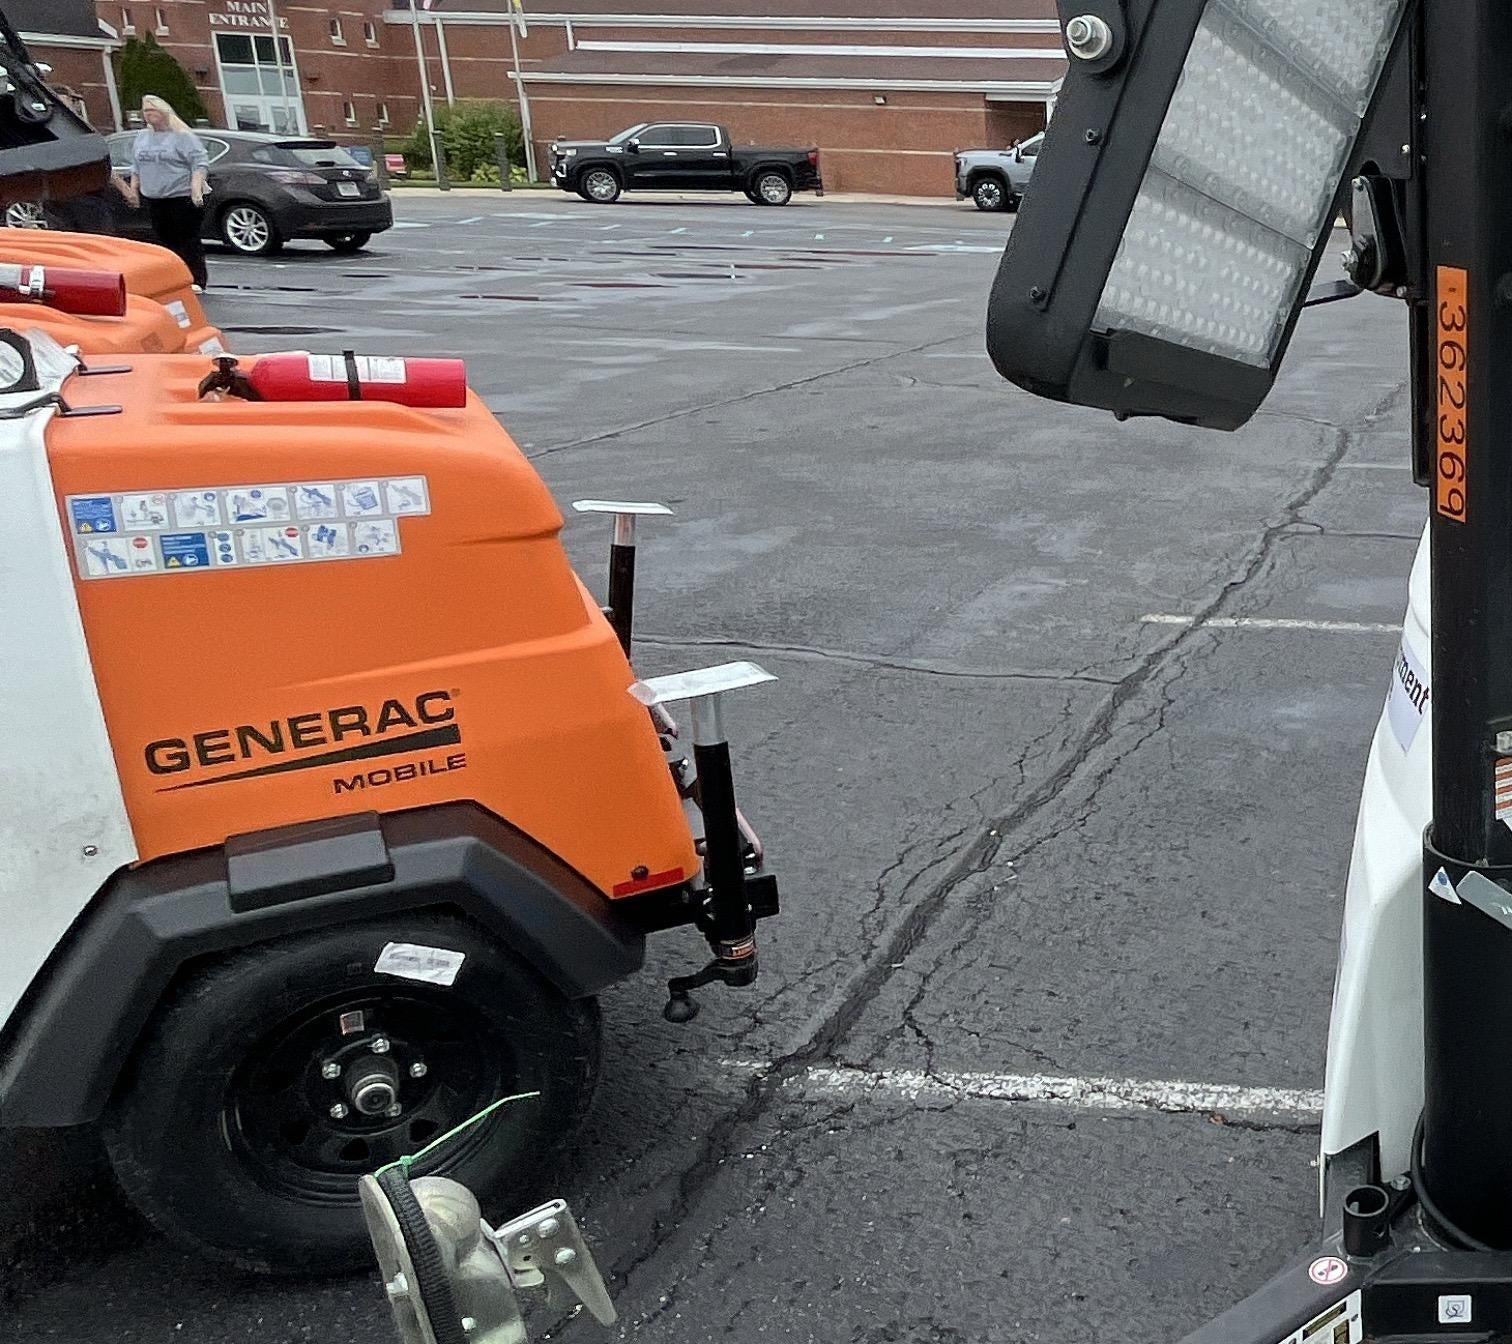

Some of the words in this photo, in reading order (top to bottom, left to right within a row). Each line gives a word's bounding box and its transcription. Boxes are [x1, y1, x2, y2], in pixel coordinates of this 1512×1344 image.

[208, 12, 290, 29] ENTRANE
[225, 0, 268, 14] MAIN
[1439, 301, 1466, 517] 362369
[144, 690, 455, 774] GENERAC
[332, 752, 468, 794] MOBILE
